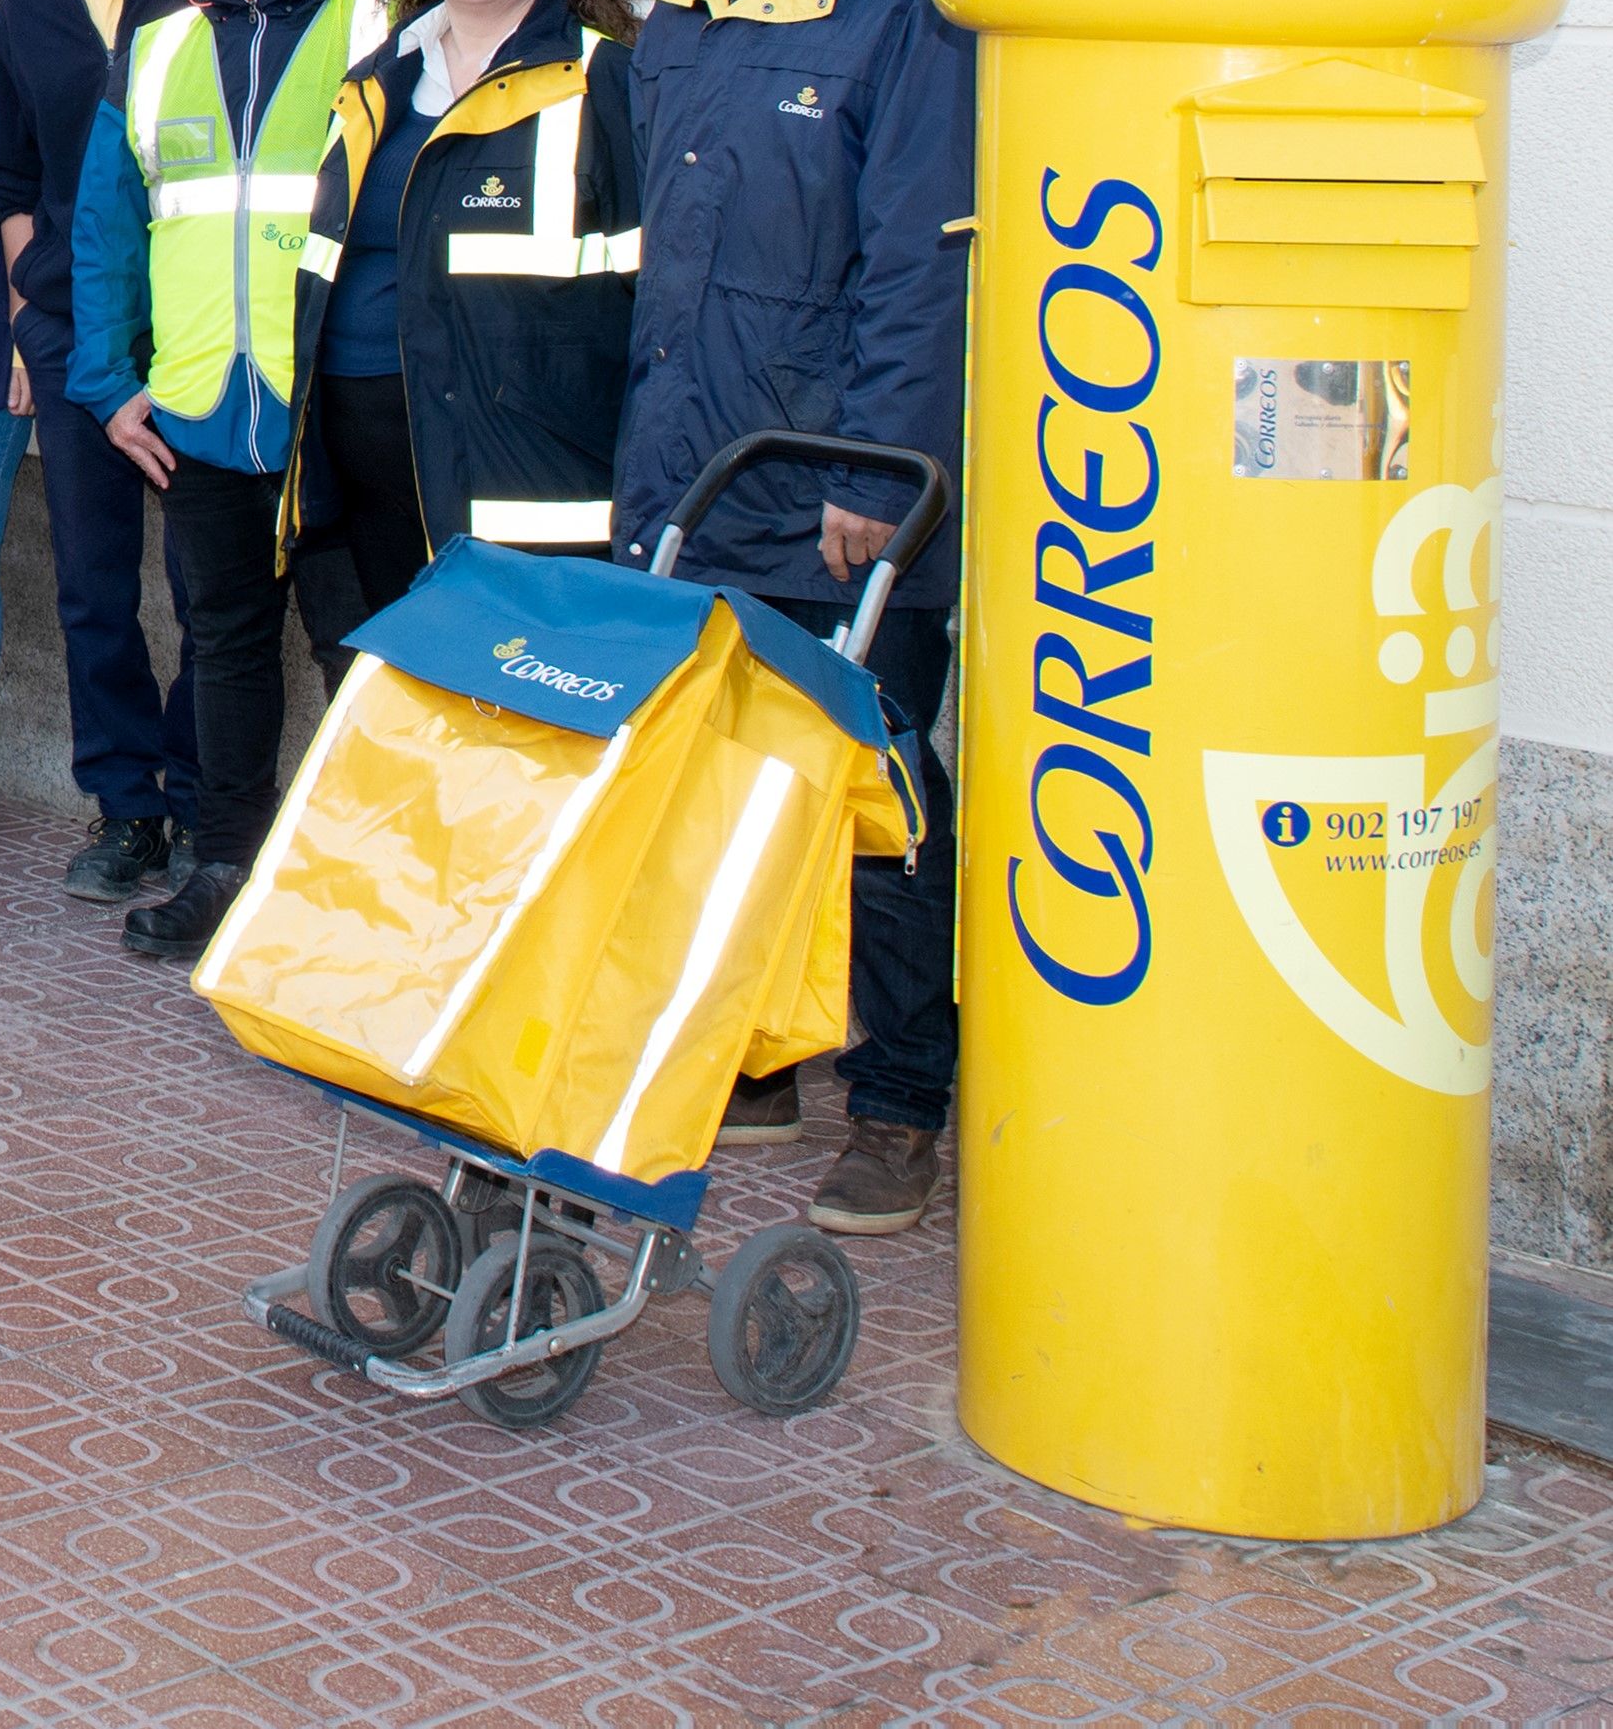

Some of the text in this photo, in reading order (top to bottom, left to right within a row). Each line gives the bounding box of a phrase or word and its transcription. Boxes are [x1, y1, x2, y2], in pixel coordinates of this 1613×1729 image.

[461, 194, 522, 209] CORREOS
[1254, 368, 1277, 470] CORREOS
[1008, 165, 1164, 1008] CORREOS
[500, 654, 624, 702] CORREOS
[1326, 797, 1483, 841] 902 197 197
[1325, 838, 1483, 873] www.correos.es
